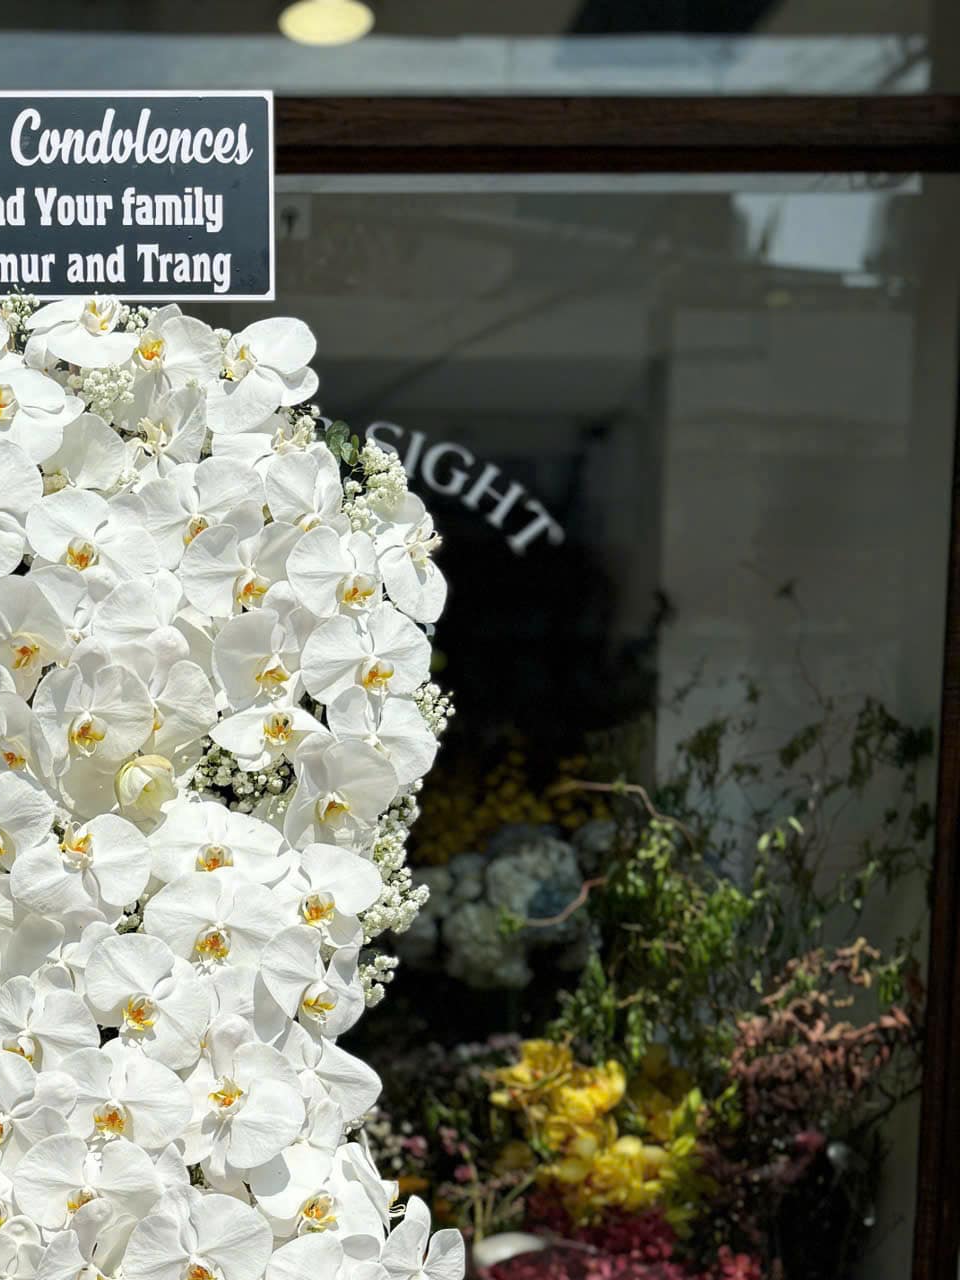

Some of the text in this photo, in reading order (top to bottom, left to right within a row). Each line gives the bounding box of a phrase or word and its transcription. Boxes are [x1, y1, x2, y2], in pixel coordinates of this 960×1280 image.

[10, 107, 254, 167] Condolences
[34, 187, 114, 227] Your
[121, 186, 224, 233] family
[66, 244, 126, 284] and
[136, 243, 232, 292] Trang
[364, 420, 565, 556] SIGHT
